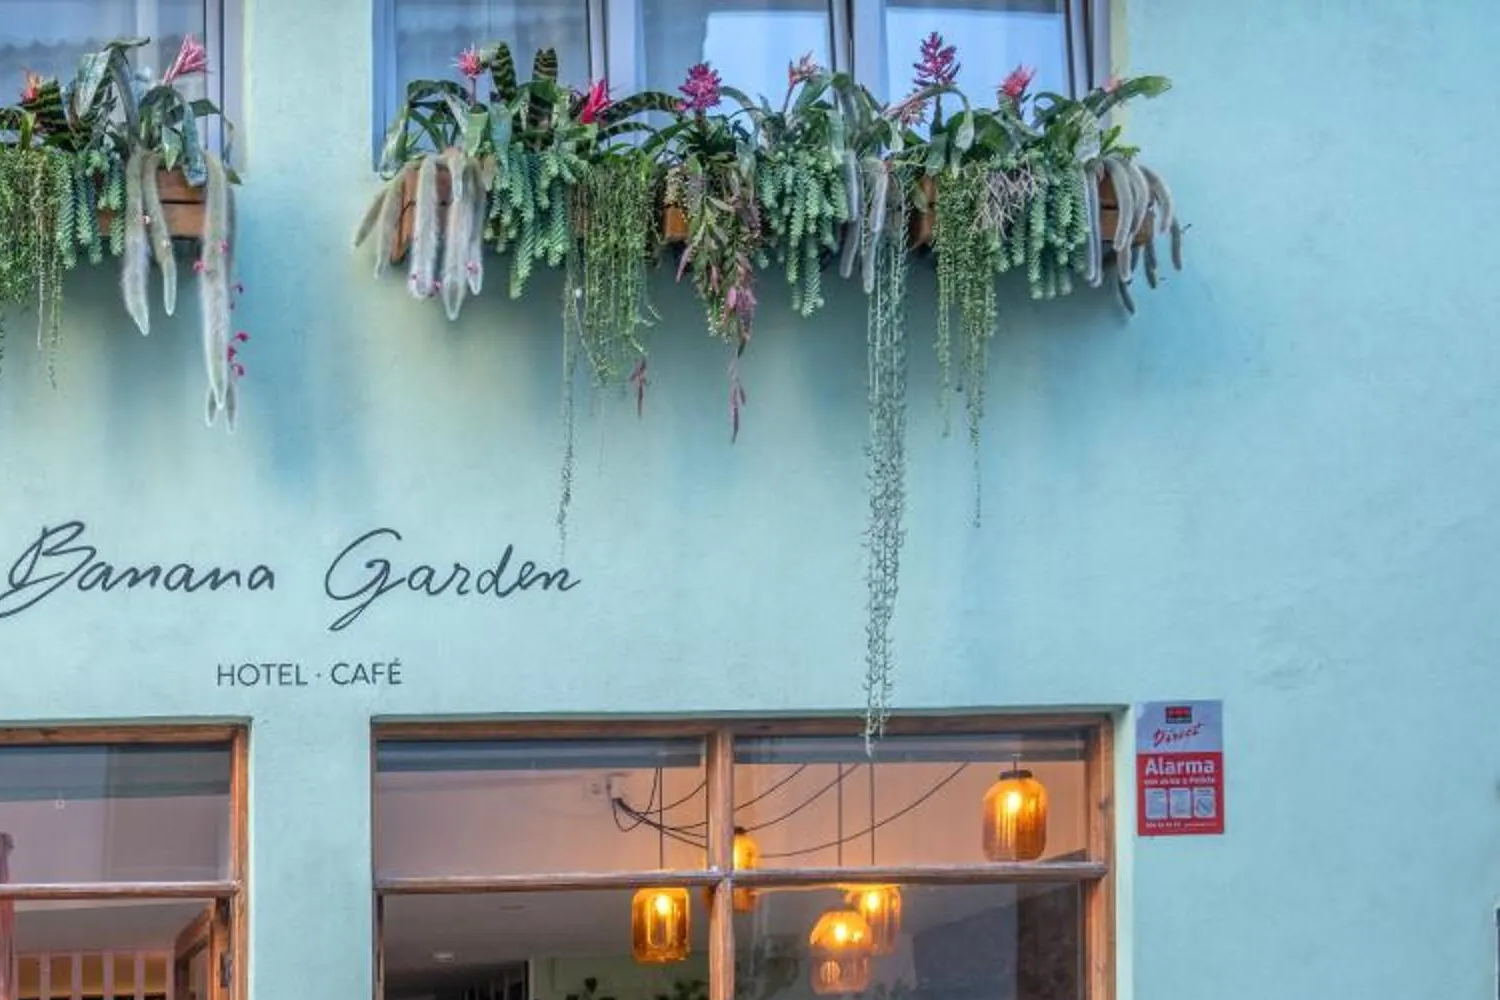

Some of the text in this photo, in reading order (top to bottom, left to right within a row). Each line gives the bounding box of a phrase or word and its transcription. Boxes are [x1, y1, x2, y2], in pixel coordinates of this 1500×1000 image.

[324, 528, 582, 631] Garden
[216, 656, 404, 687] HOTEL CAFÉ
[1144, 757, 1216, 776] Alarma
